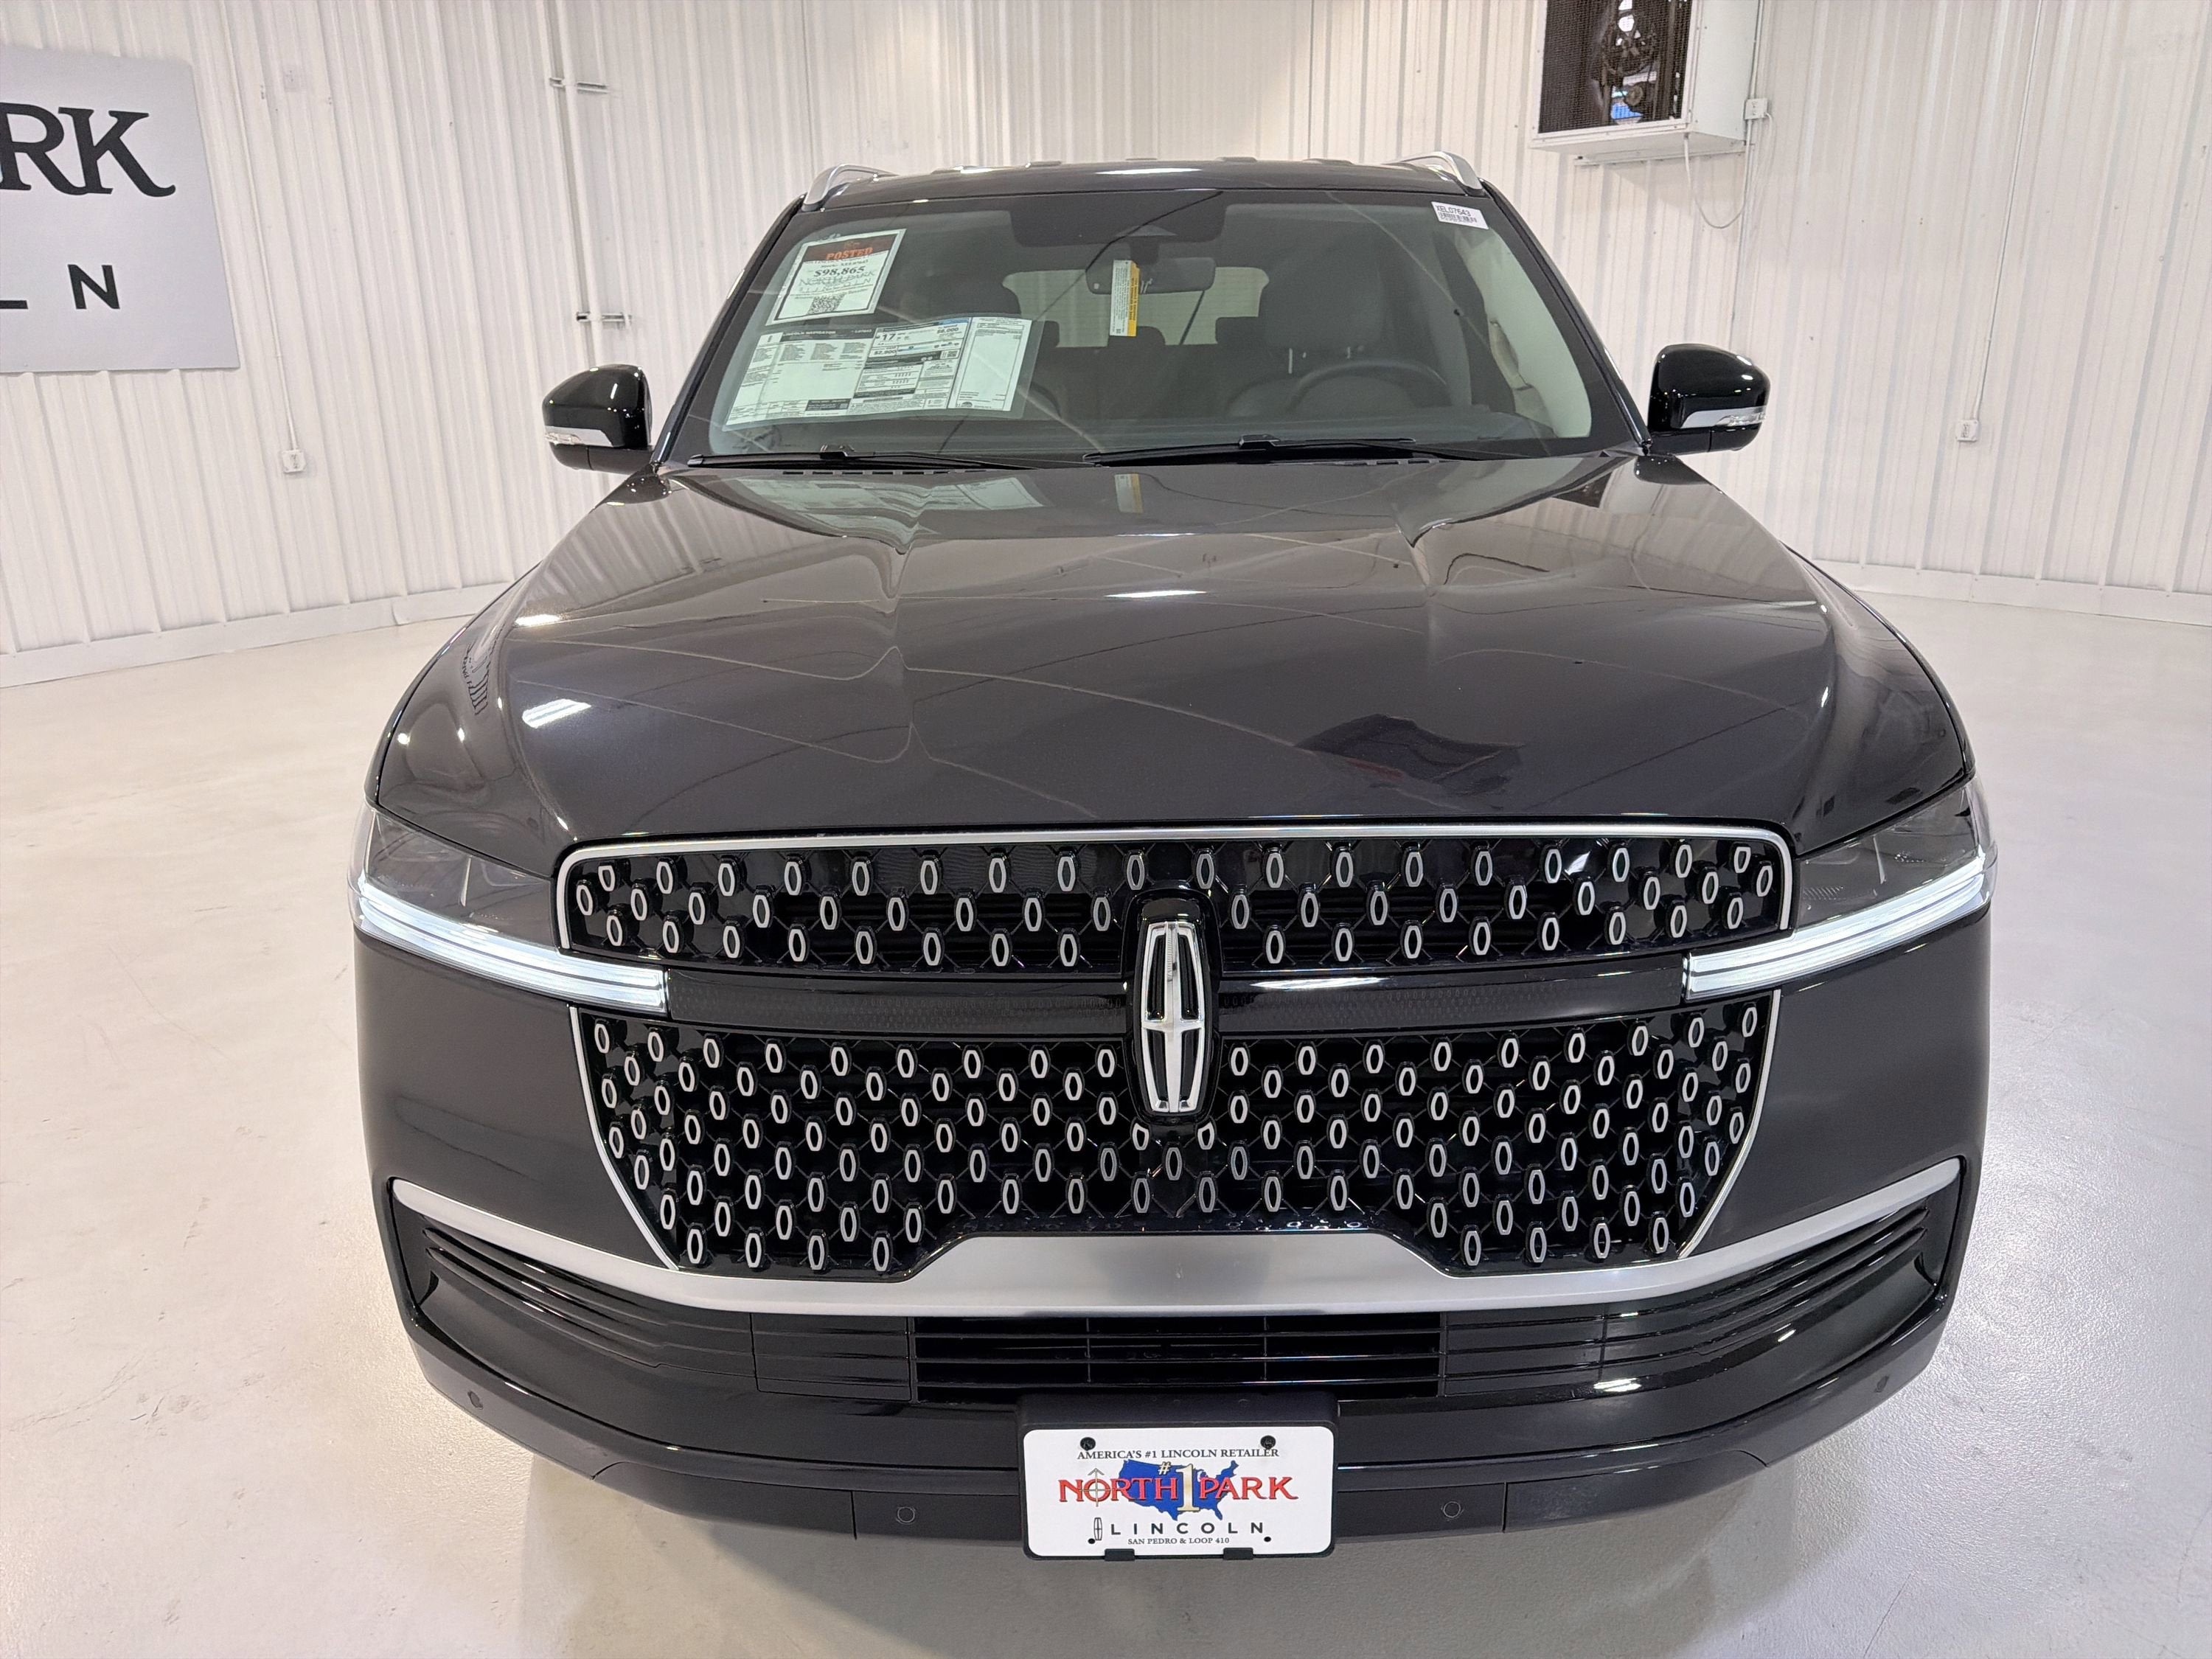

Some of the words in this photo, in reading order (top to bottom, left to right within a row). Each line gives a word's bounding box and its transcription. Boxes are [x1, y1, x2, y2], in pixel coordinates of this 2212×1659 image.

[825, 247, 874, 260] POSTED
[813, 265, 866, 277] $98,865
[1144, 1450, 1158, 1458] #1
[1161, 1450, 1217, 1458] LINCOLN
[1220, 1449, 1280, 1458] RETAILER
[1058, 1477, 1178, 1503] NORTH
[1199, 1476, 1299, 1500] PARK
[1110, 1521, 1264, 1535] LINCOLN
